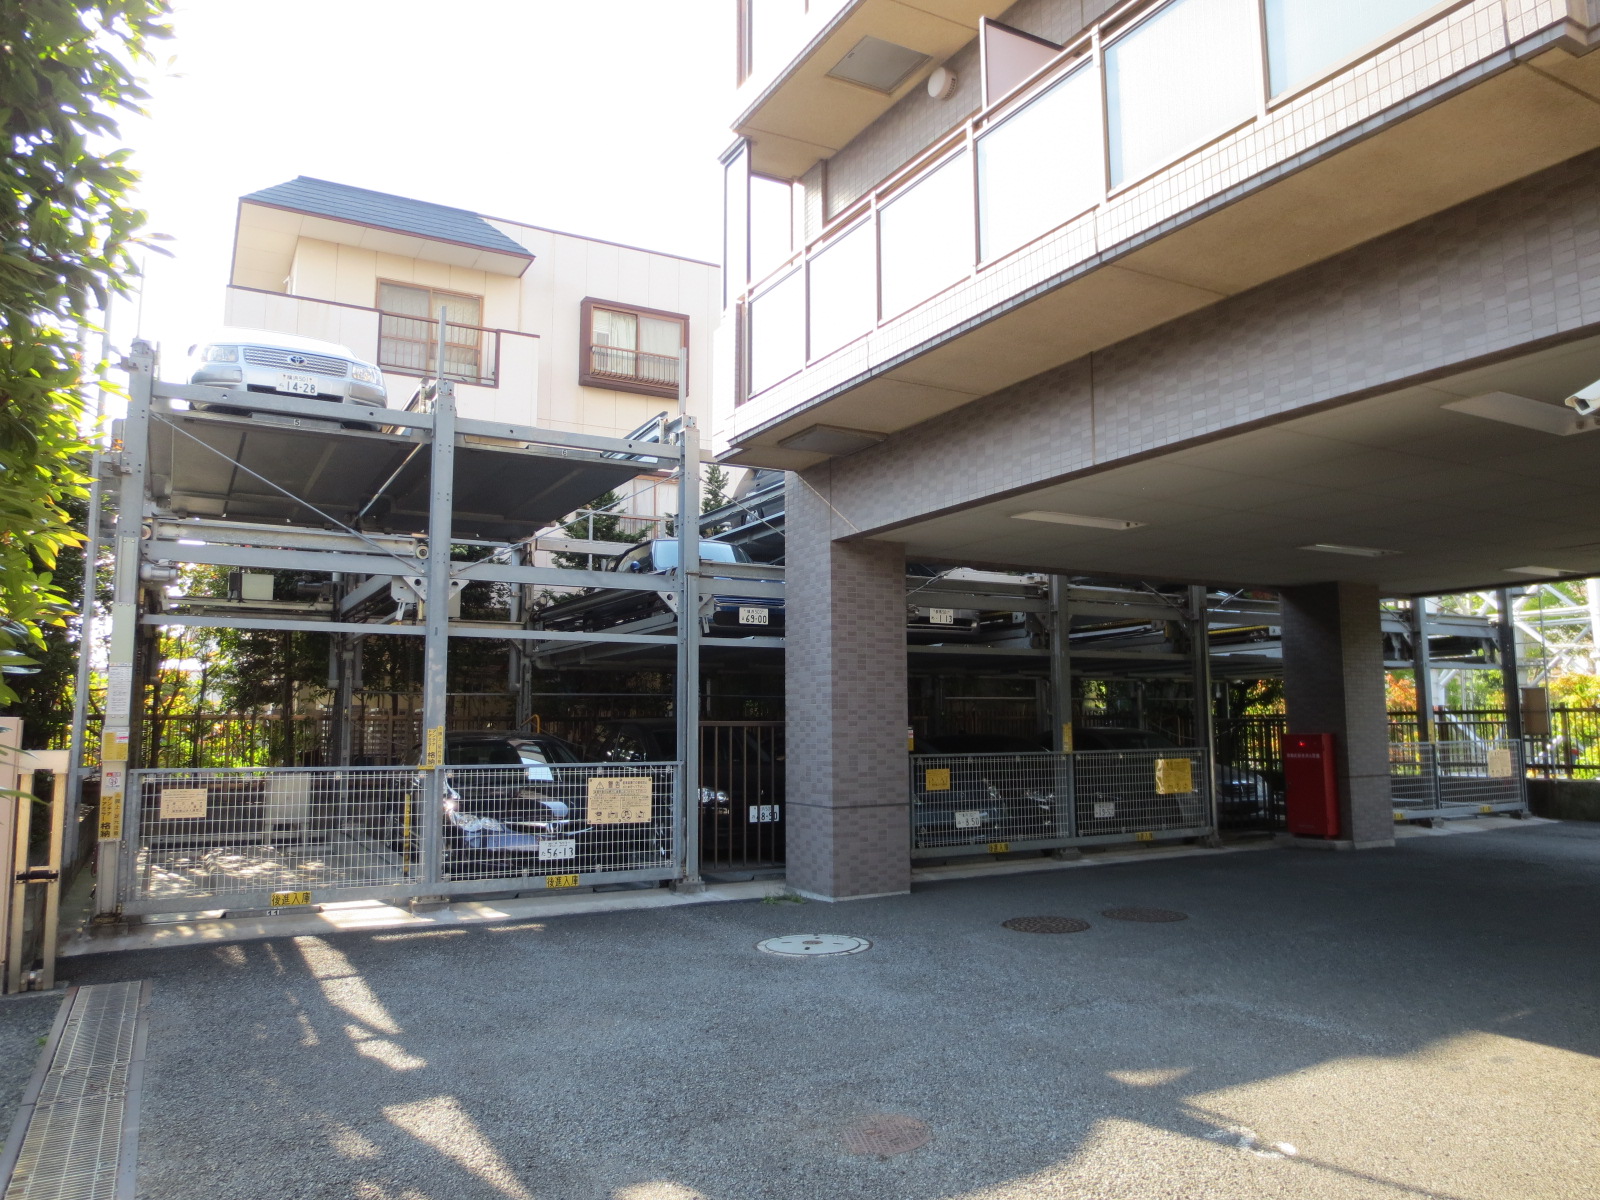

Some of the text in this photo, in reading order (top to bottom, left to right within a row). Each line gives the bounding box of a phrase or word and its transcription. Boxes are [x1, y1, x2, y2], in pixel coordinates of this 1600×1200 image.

[287, 381, 316, 394] 14-28
[745, 614, 767, 624] 69-00
[608, 780, 620, 789] 警告
[100, 822, 111, 838] 格納
[547, 846, 574, 859] 56-13
[547, 875, 579, 888] 後進入庫
[271, 892, 311, 906] 後進入庫
